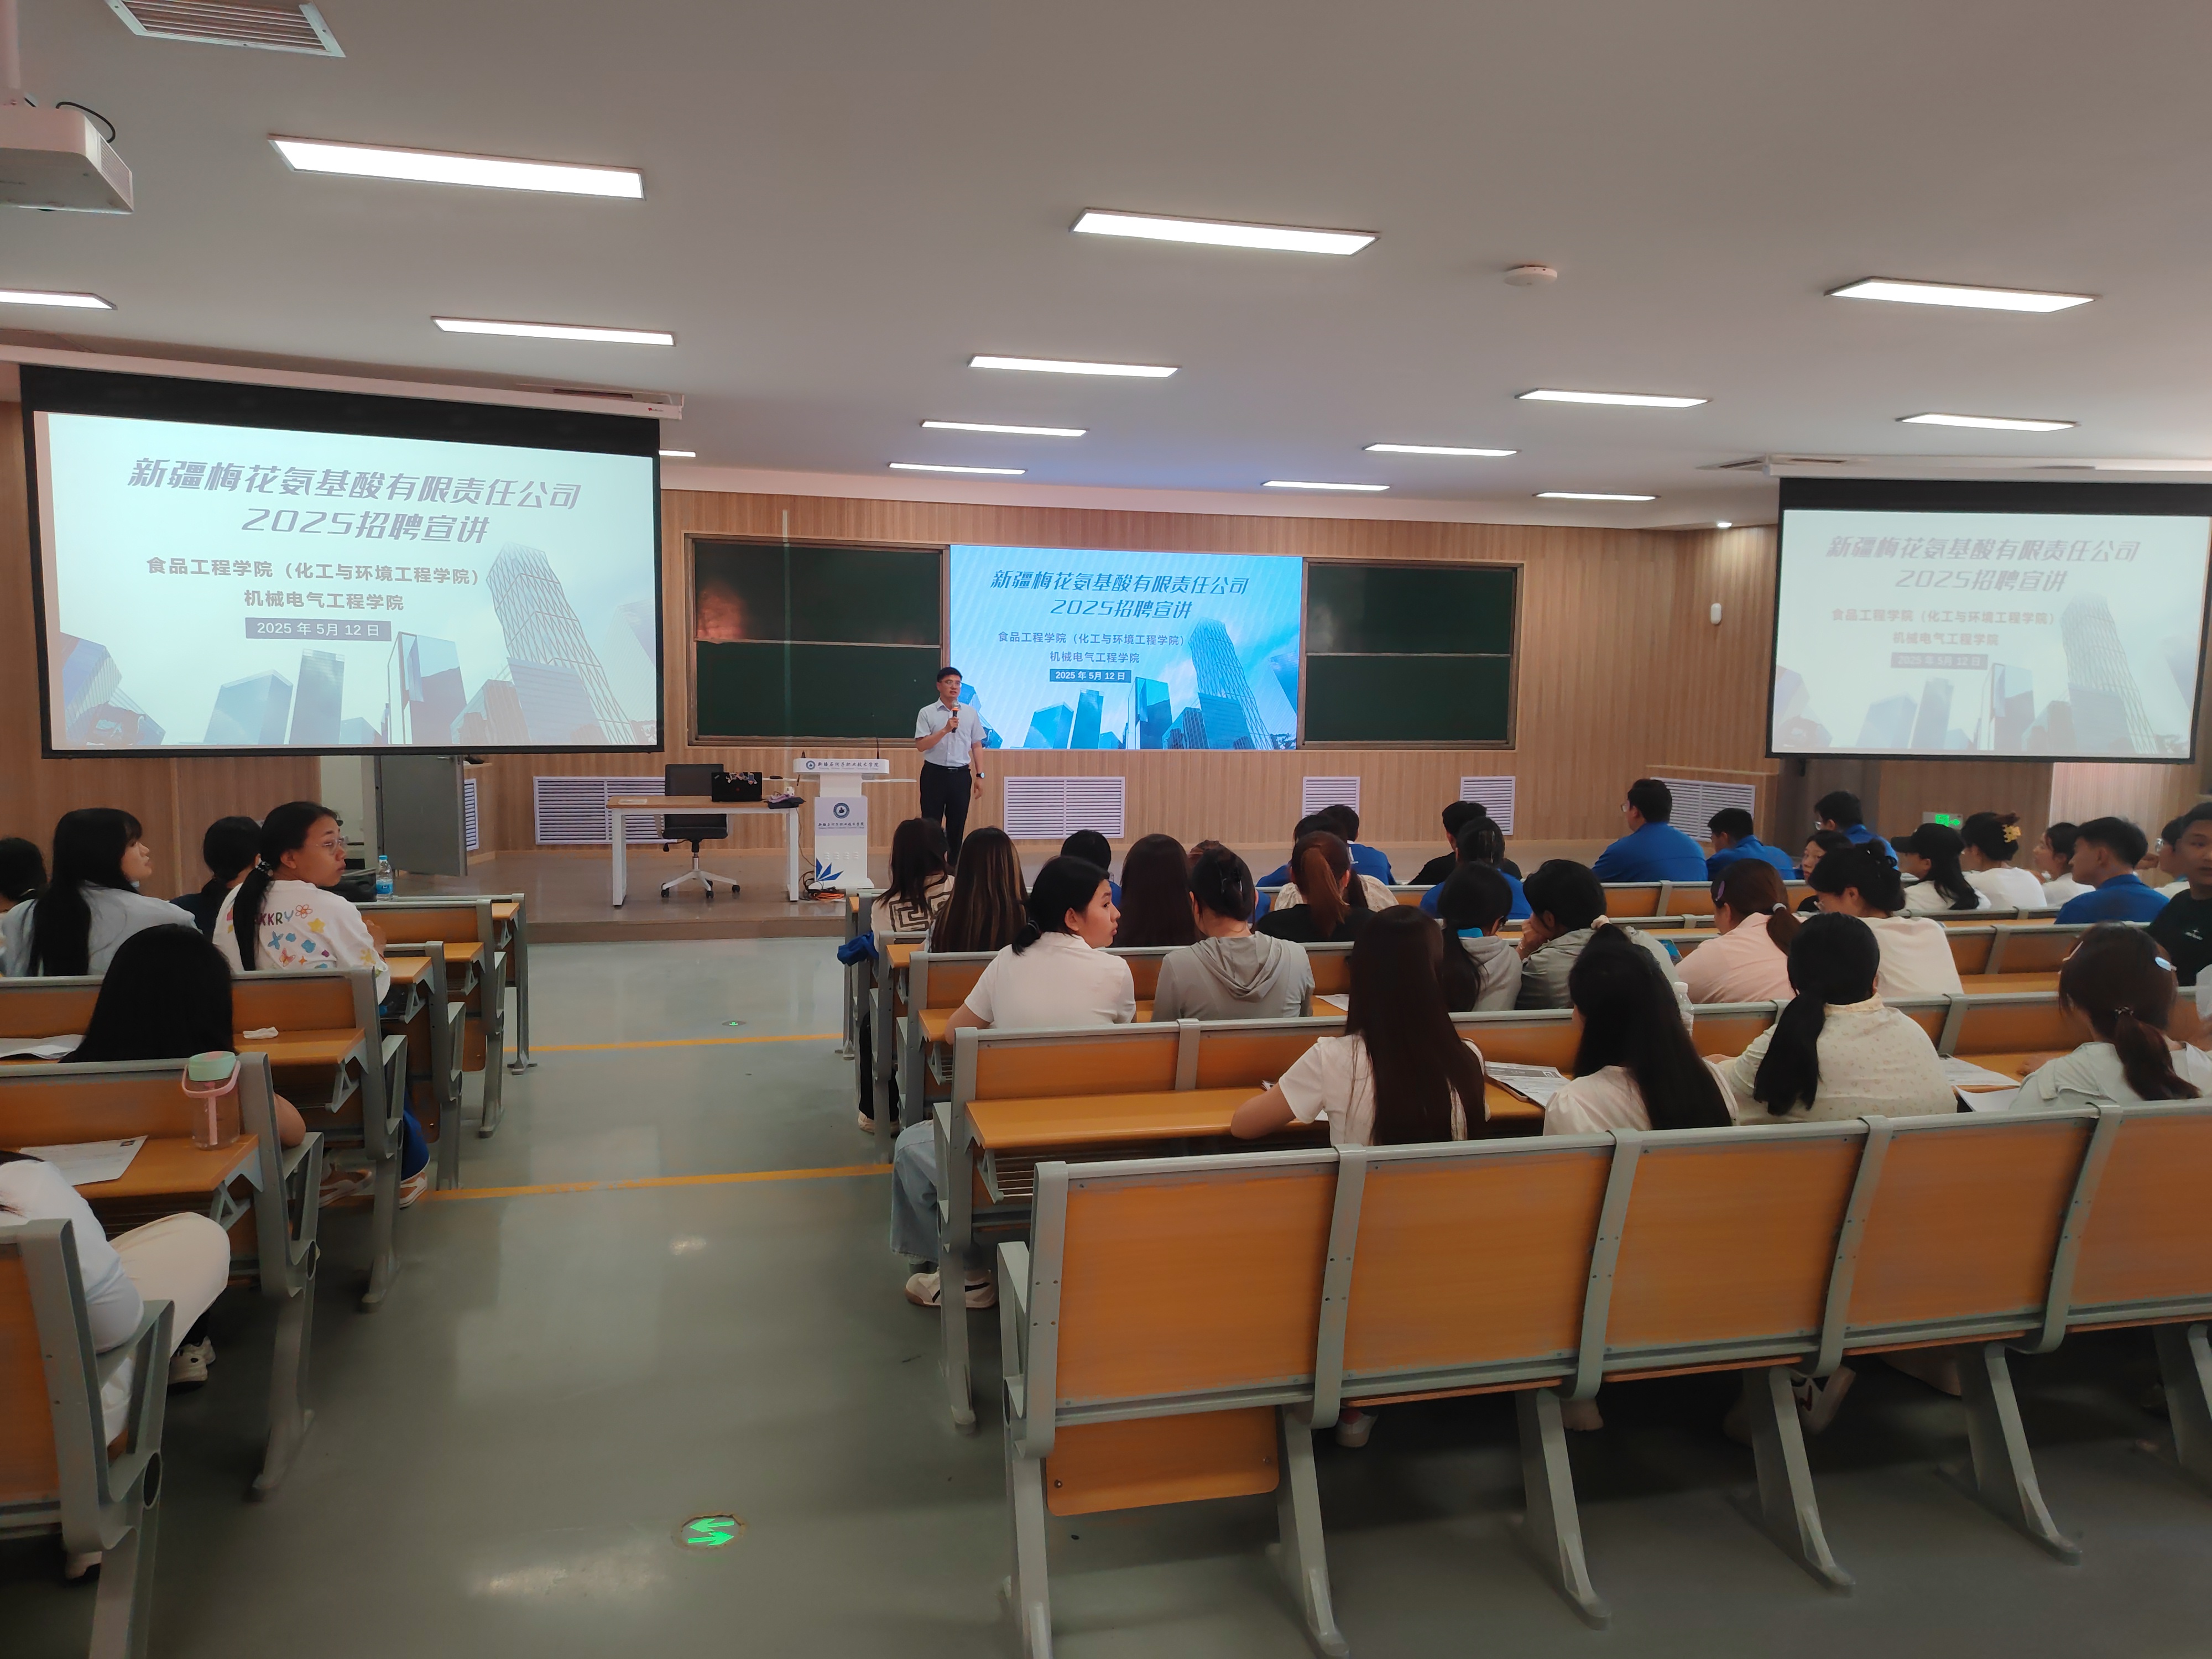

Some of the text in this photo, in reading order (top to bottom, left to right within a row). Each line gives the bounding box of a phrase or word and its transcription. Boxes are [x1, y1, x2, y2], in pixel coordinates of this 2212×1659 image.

[128, 456, 581, 511] 新疆梅花氨基酸有限责任公司
[241, 507, 490, 545] 2025招聘宣讲
[1826, 535, 2141, 562] 新疆梅花氨基酸有限责任公司
[990, 570, 1249, 595] 新疆梅花氨基酸有限责任公司
[1895, 570, 2068, 592] 2025招聘宣讲
[244, 589, 404, 612] 机械电气工程学院
[1051, 599, 1192, 619] 2025招聘宣讲
[257, 622, 379, 637] 2025 年 5月 12 日
[1050, 651, 1140, 664] 机械电气工程学院
[1055, 671, 1125, 680] 2025 年 5月 12 日
